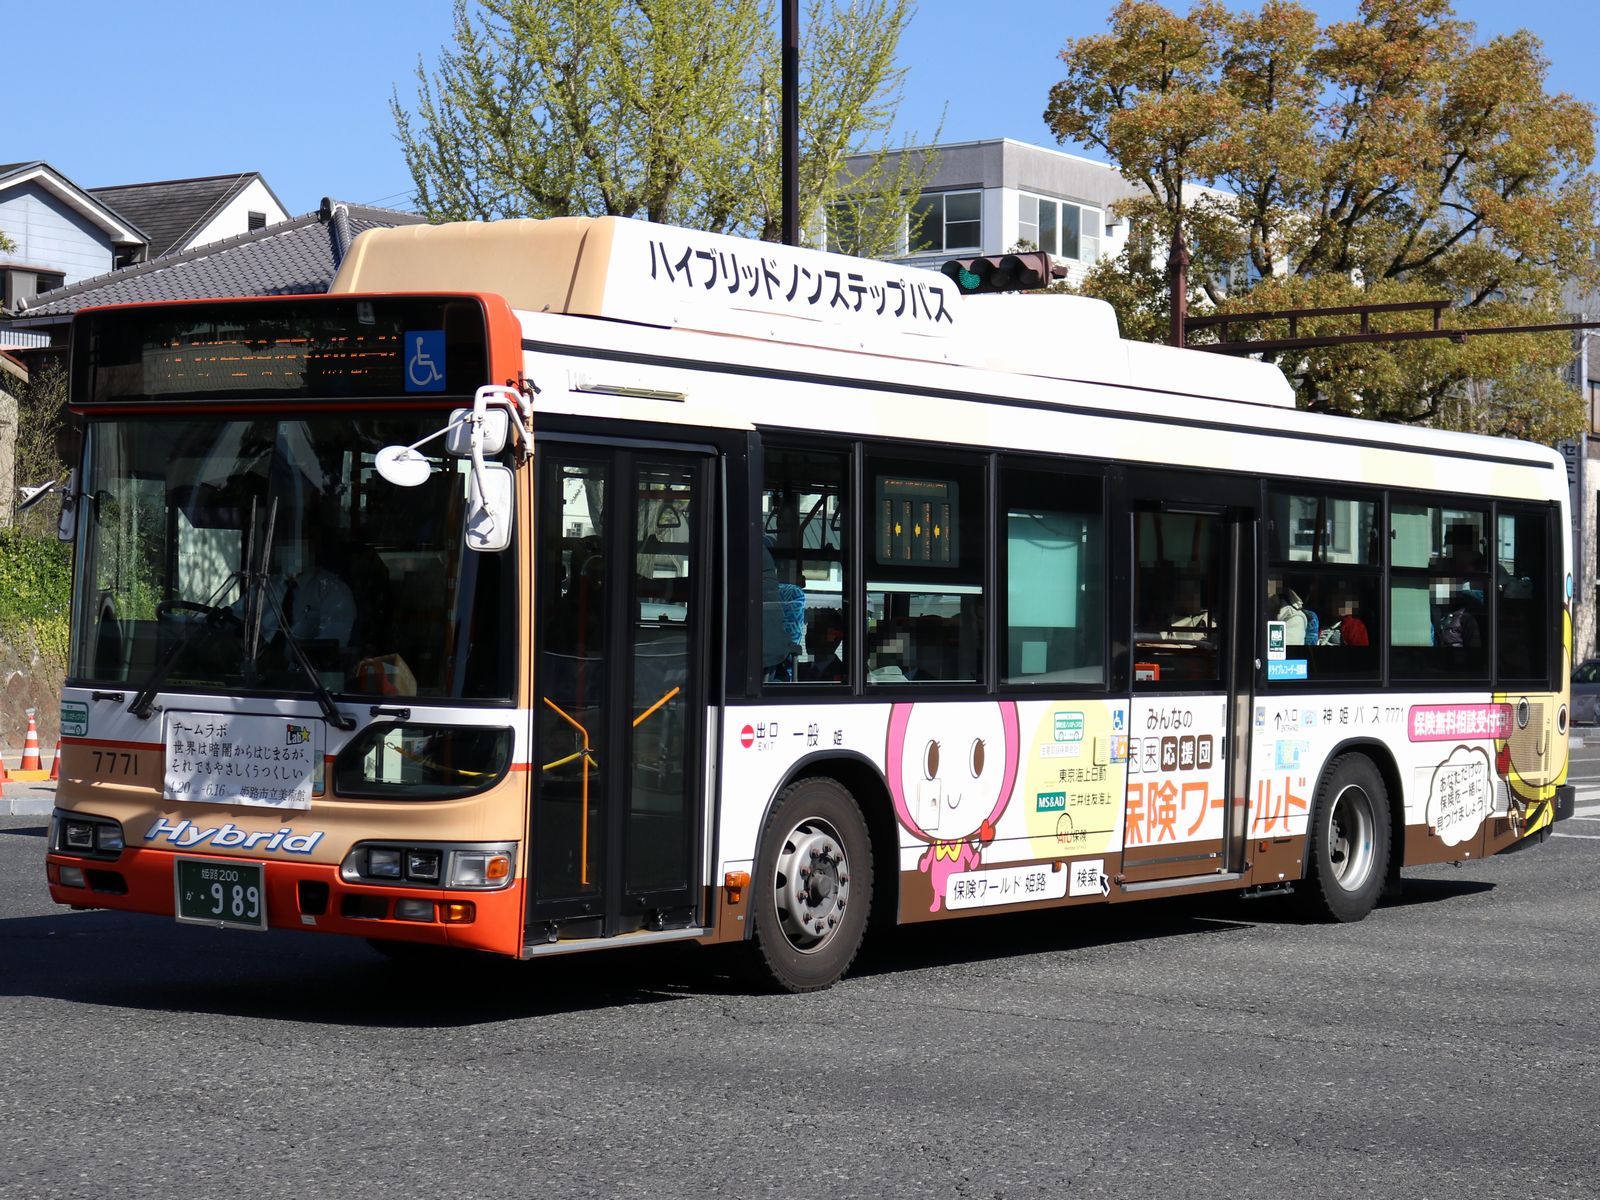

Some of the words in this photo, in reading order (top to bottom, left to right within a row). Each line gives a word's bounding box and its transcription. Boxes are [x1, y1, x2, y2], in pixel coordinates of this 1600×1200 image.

[1147, 707, 1193, 730] みんなの
[173, 722, 228, 738] チームラボ
[756, 721, 778, 738] 出口
[793, 723, 819, 747] 一般
[833, 729, 843, 746] 姫
[173, 741, 310, 763] 世界は暗闇からはじまるが、
[758, 741, 774, 751] EXIT
[92, 751, 138, 775] 7771
[172, 759, 304, 780] それでもやさしくうつくしい
[1059, 767, 1107, 783] 東京海上日動
[240, 785, 305, 802] 姫路市立美術館
[1038, 796, 1065, 808] MS&AD
[1070, 792, 1111, 806] 三井住友海上
[144, 817, 325, 855] Hybrid
[954, 875, 1021, 901] 保険ワールド
[1025, 873, 1047, 893] 姫路
[1077, 868, 1098, 888] 検索
